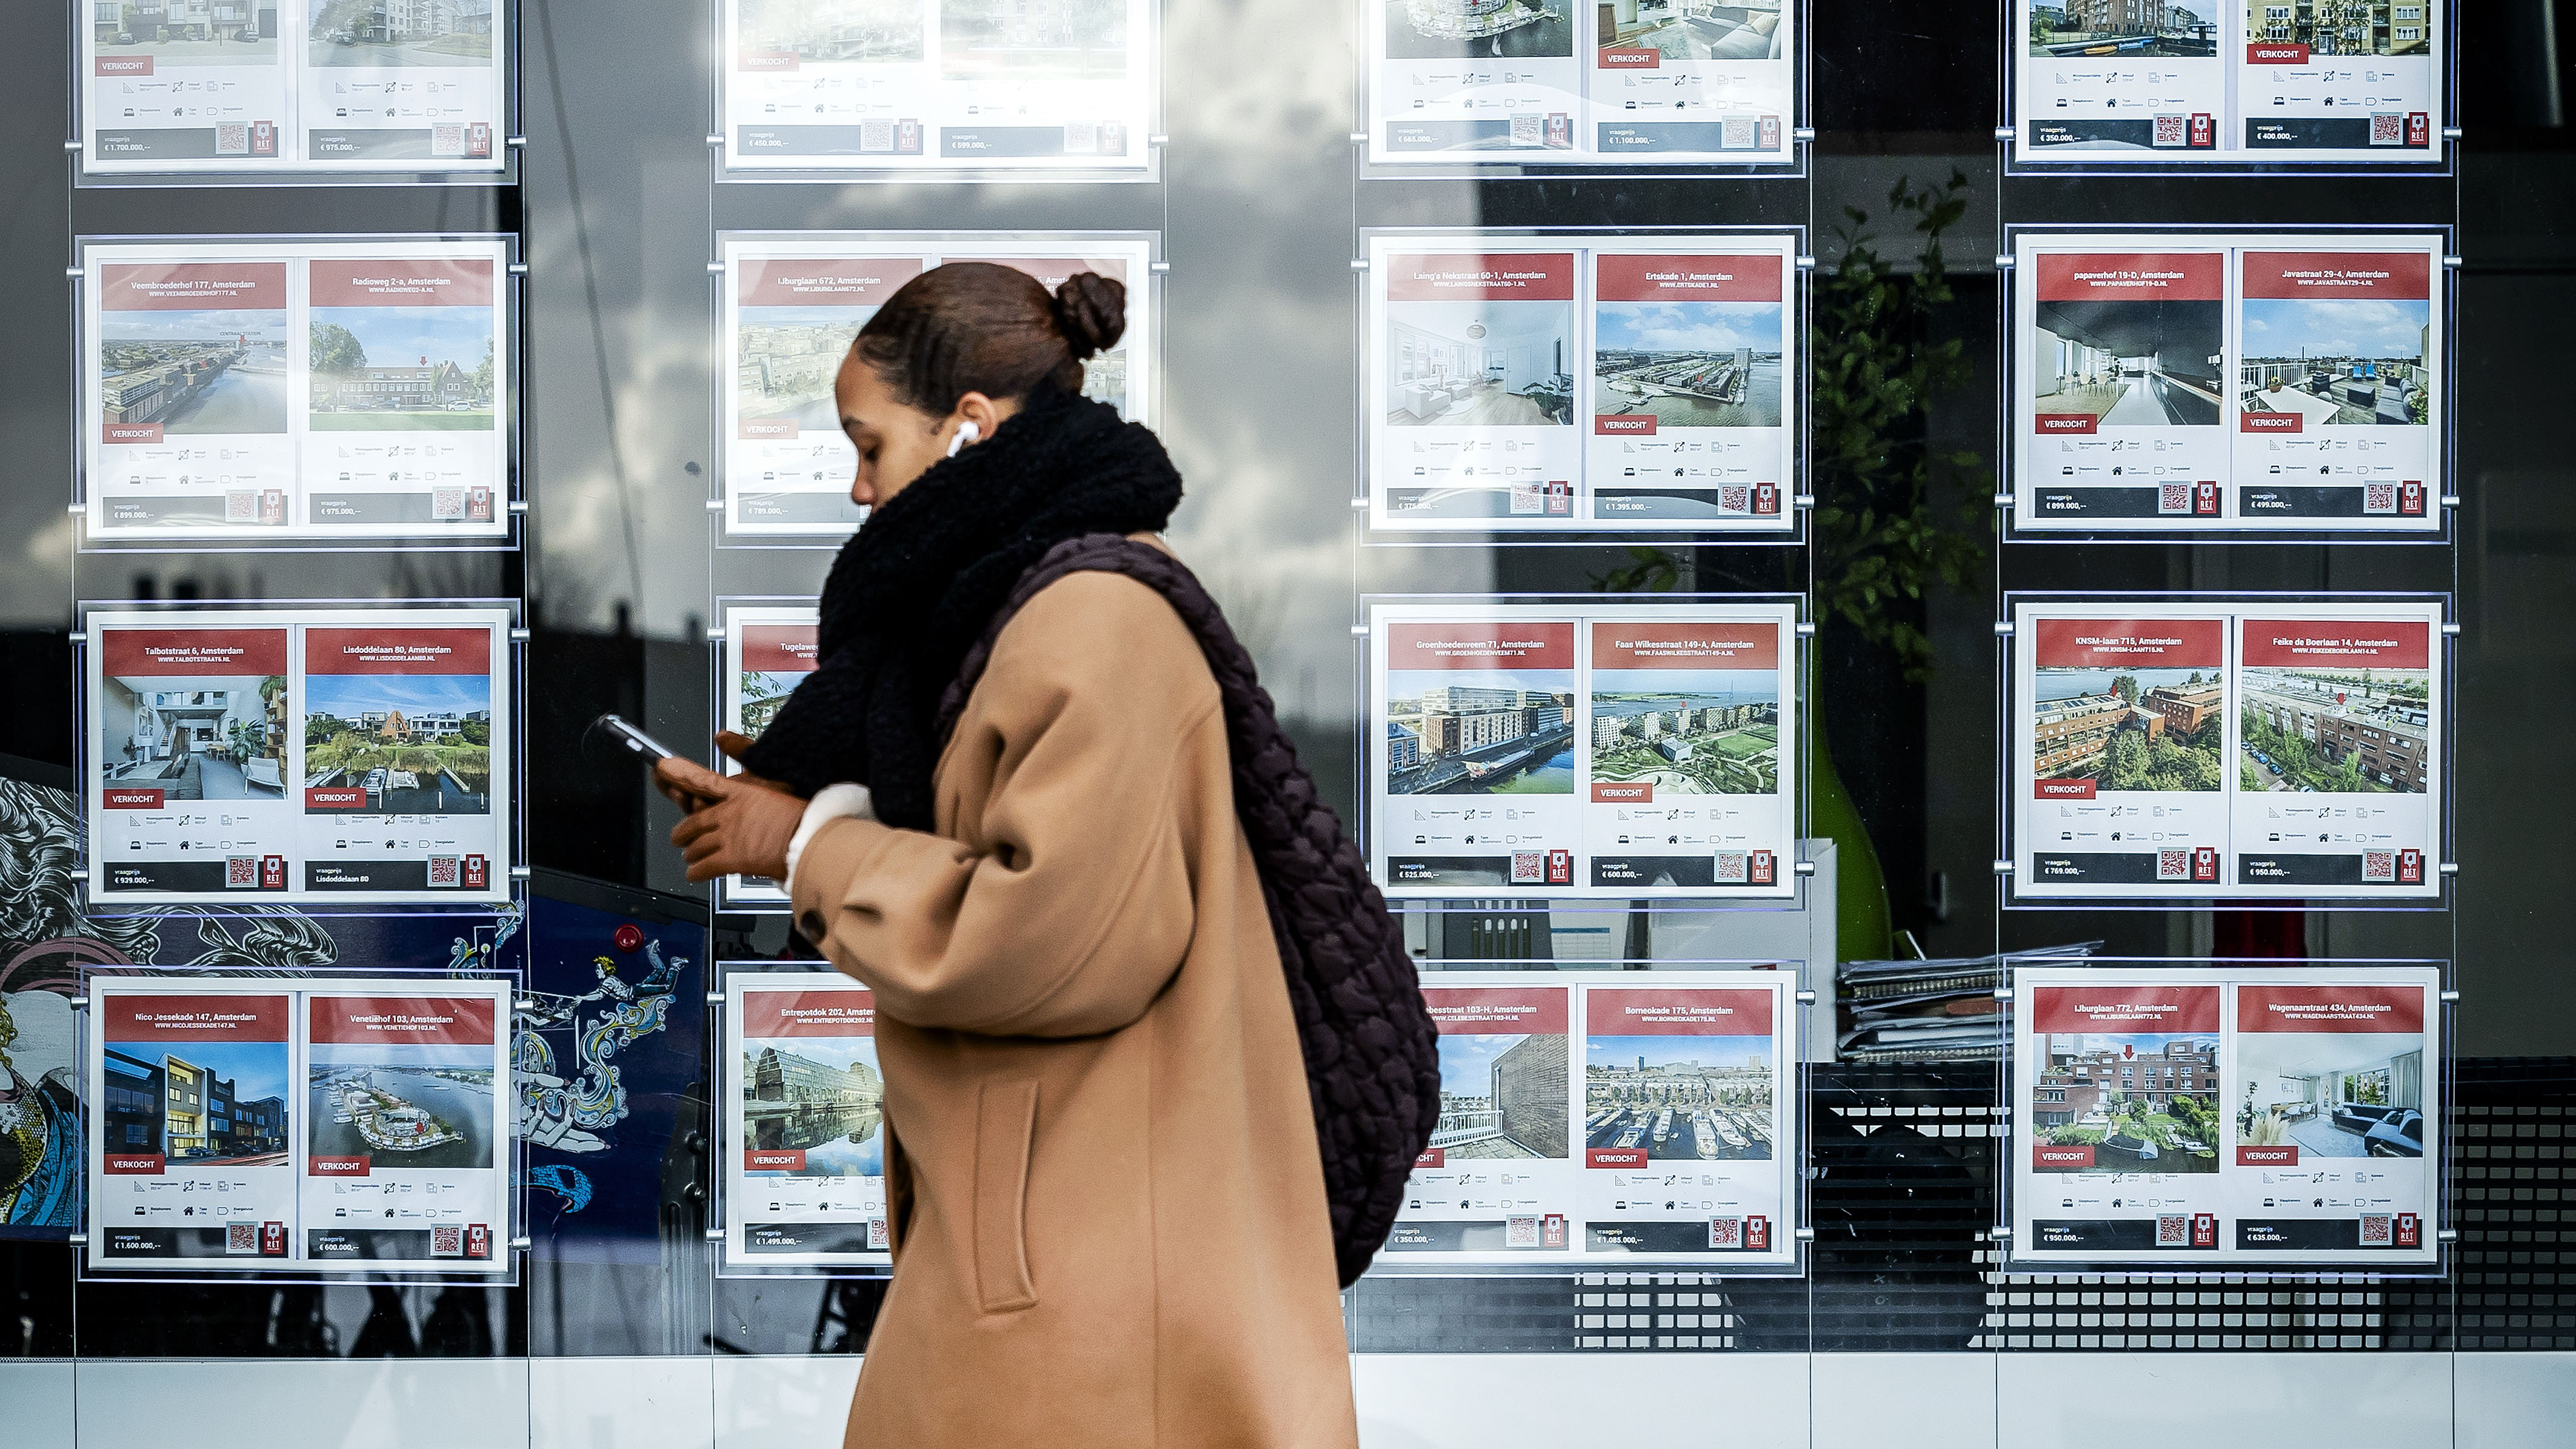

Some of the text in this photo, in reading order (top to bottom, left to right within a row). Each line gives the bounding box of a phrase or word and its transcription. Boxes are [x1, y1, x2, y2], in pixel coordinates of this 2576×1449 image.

[1413, 272, 1440, 281] Laing's
[1481, 272, 1501, 281] 60-1,
[2074, 272, 2117, 281] papaverhof
[2118, 272, 2139, 280] 19-D,
[2324, 270, 2344, 279] 29-4,
[131, 281, 193, 290] Veembroederhof
[195, 281, 211, 290] 177,
[352, 278, 389, 287] Radioweg
[391, 278, 406, 286] 2-a,
[778, 278, 818, 286] IJburglaan
[1604, 421, 1646, 429] VERKOCHT
[2044, 420, 2087, 428] VERKOCHT
[2249, 418, 2292, 427] VERKOCHT
[1487, 641, 1500, 649] 71,
[1683, 641, 1709, 649] 149-A,
[2120, 637, 2137, 646] 715,
[2341, 638, 2353, 647] 14,
[1600, 789, 1643, 797] VERKOCHT
[1671, 1007, 1688, 1016] 175,
[2074, 1005, 2114, 1013] IJburglaan
[2115, 1005, 2132, 1013] 772,
[2269, 1004, 2328, 1012] Wagenaarstraat
[2329, 1004, 2346, 1012] 434,
[196, 1013, 212, 1022] 147,
[781, 1009, 827, 1017] Entrepotdok
[392, 1015, 409, 1023] 103,
[410, 1015, 453, 1023] Amsterdam
[753, 1156, 796, 1165] VERKOCHT
[1595, 1154, 1637, 1163] VERKOCHT
[2042, 1152, 2084, 1160] VERKOCHT
